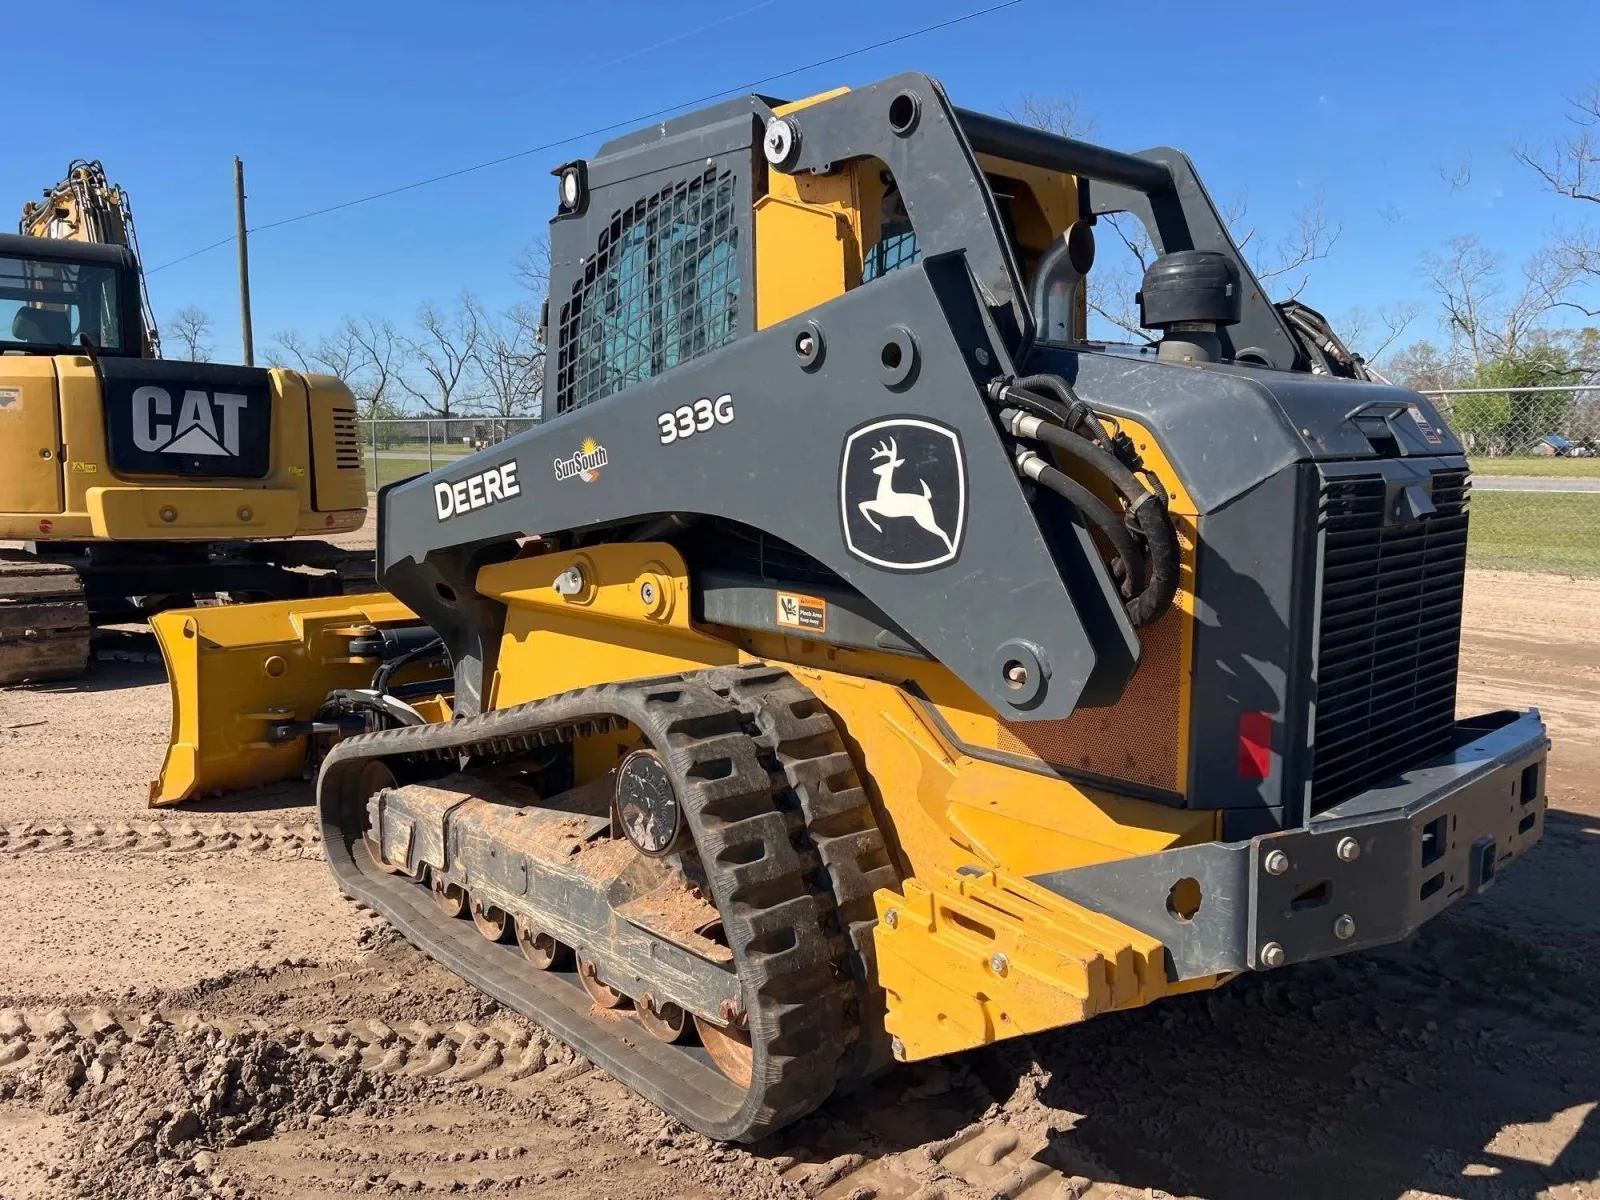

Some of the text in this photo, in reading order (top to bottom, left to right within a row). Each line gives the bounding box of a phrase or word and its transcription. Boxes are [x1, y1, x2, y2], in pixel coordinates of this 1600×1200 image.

[132, 386, 247, 456] CAT
[657, 394, 735, 444] 333G
[554, 447, 608, 479] SunSouth
[434, 461, 520, 520] DEERE
